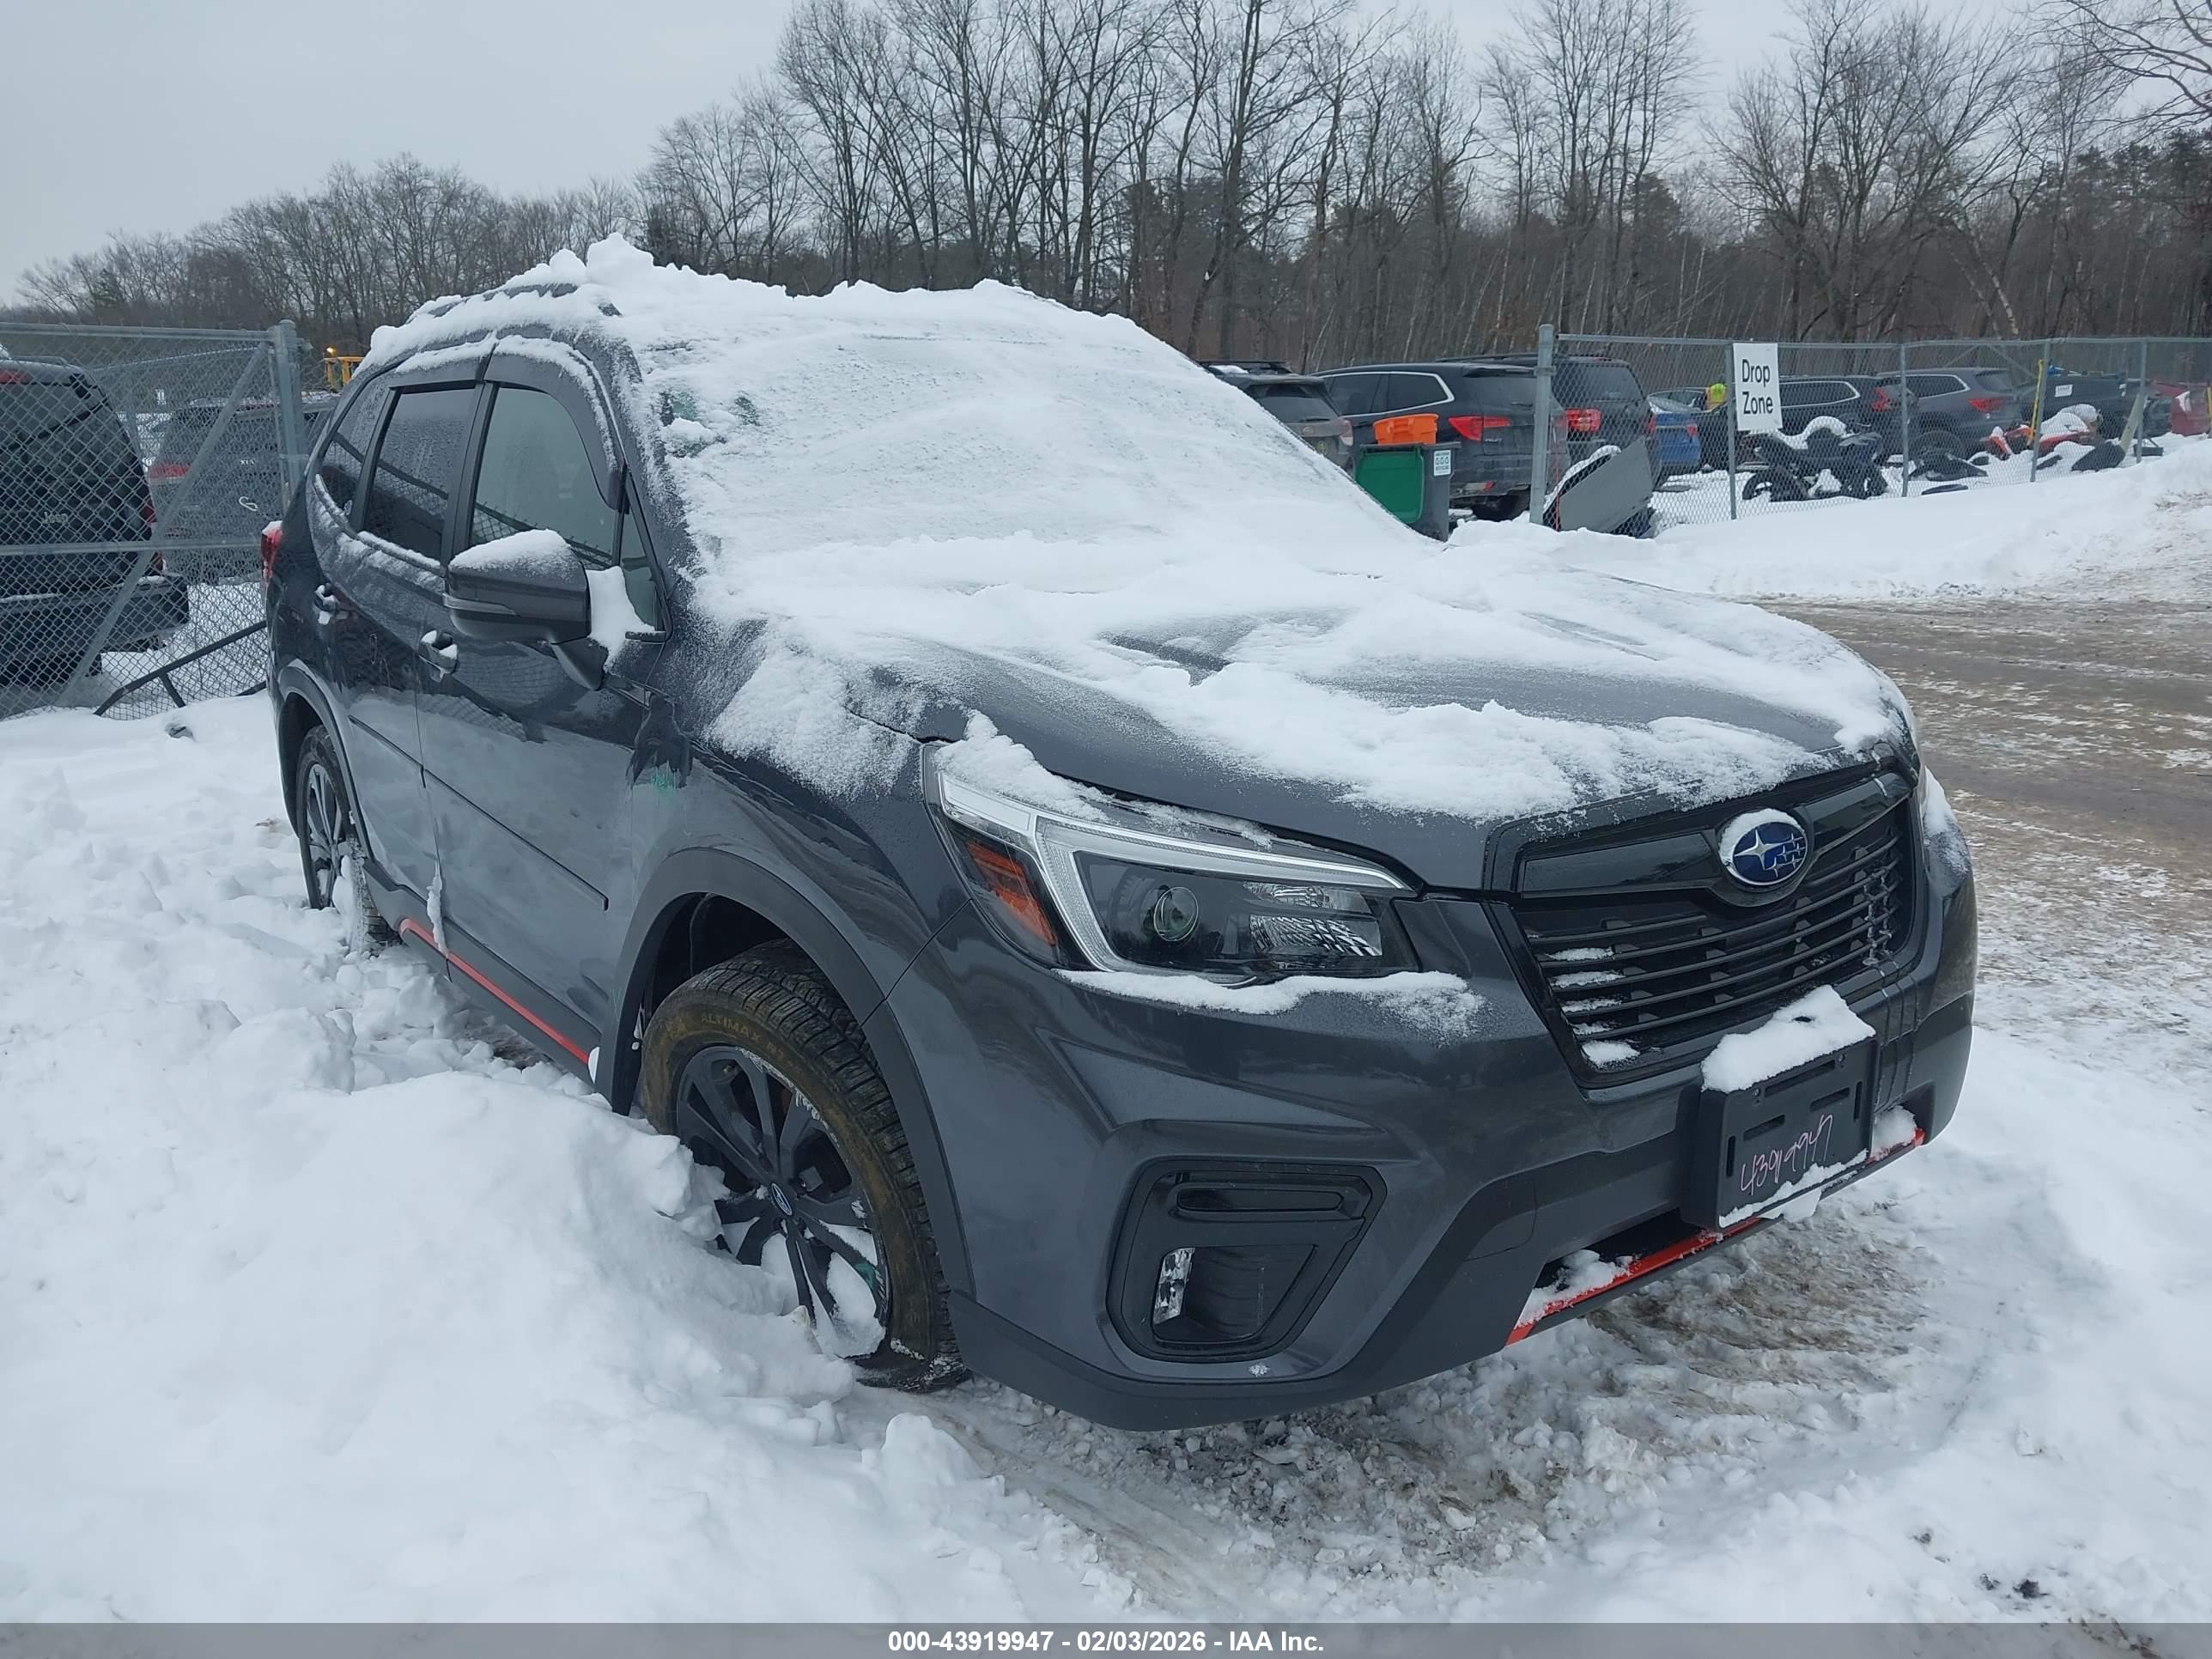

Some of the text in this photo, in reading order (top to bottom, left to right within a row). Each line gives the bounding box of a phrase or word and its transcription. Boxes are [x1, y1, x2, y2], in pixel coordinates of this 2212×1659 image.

[1742, 359, 1771, 388] Drop
[1742, 392, 1773, 415] Zone
[40, 511, 69, 525] Jeep
